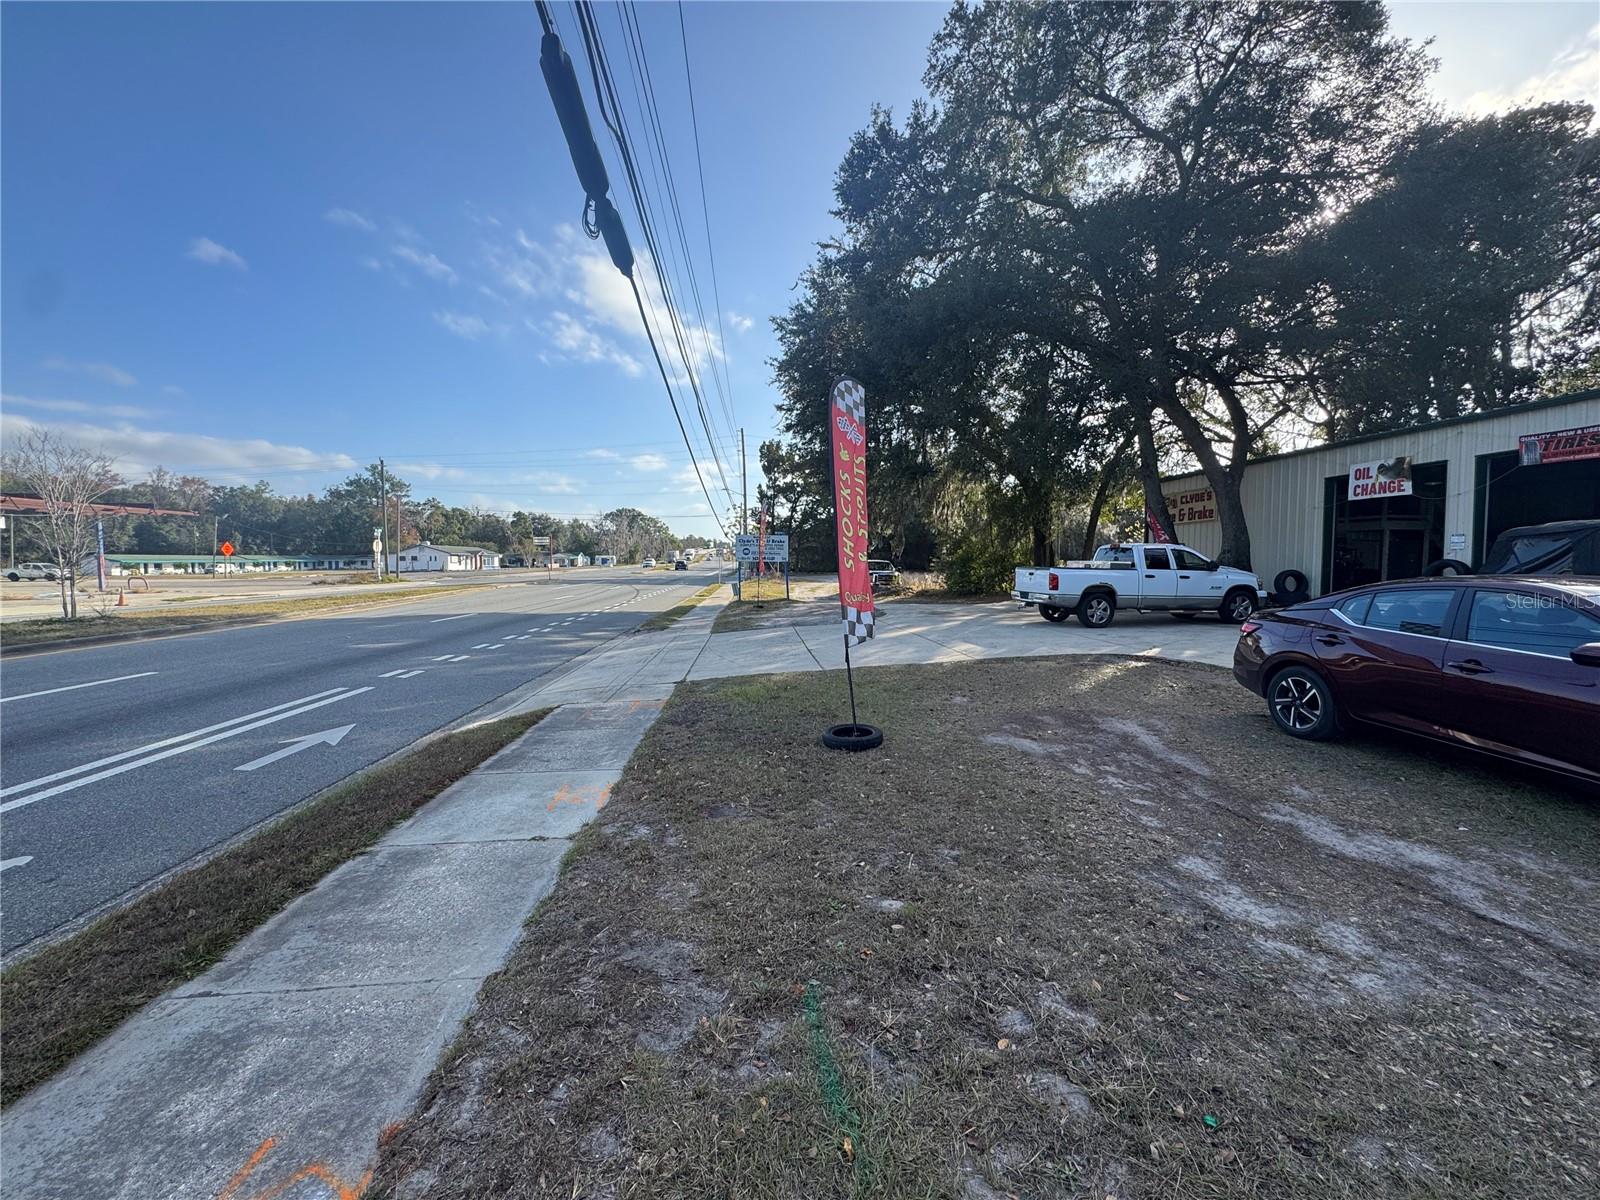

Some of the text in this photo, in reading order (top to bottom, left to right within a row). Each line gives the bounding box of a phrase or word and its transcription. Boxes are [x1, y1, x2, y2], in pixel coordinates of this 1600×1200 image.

[1520, 434, 1550, 442] QUALITY
[1540, 433, 1600, 453] TIRES
[1354, 467, 1373, 481] OIL
[1353, 479, 1405, 497] CHANGE
[1180, 489, 1212, 505] CLYDE'S
[839, 469, 855, 572] SHOCKS
[1178, 508, 1186, 521] &
[1188, 506, 1214, 521] Brake
